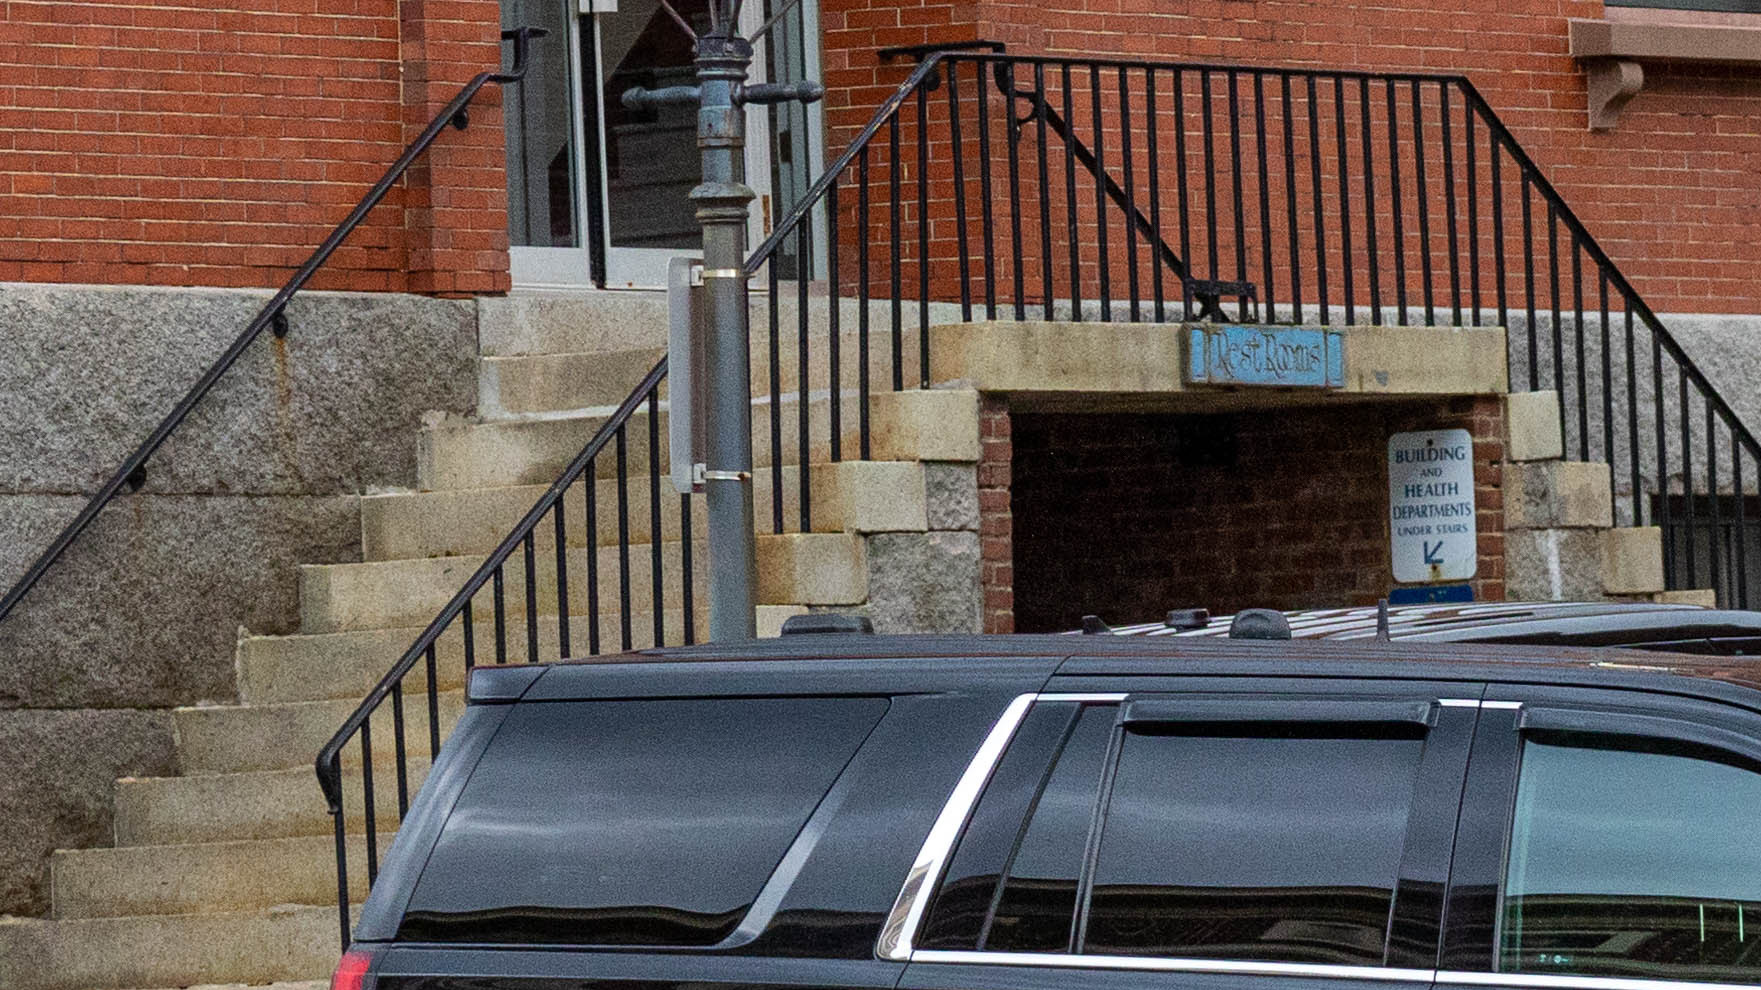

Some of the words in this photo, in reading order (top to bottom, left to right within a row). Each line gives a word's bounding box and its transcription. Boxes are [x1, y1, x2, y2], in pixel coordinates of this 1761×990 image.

[1213, 331, 1260, 378] Rest
[1395, 446, 1465, 464] BUILDING
[1420, 468, 1443, 478] AND
[1405, 482, 1459, 498] HEALTH
[1393, 502, 1472, 520] DEPARTMENTS
[1397, 525, 1432, 537] UNDER
[1436, 523, 1469, 535] STAIRS
